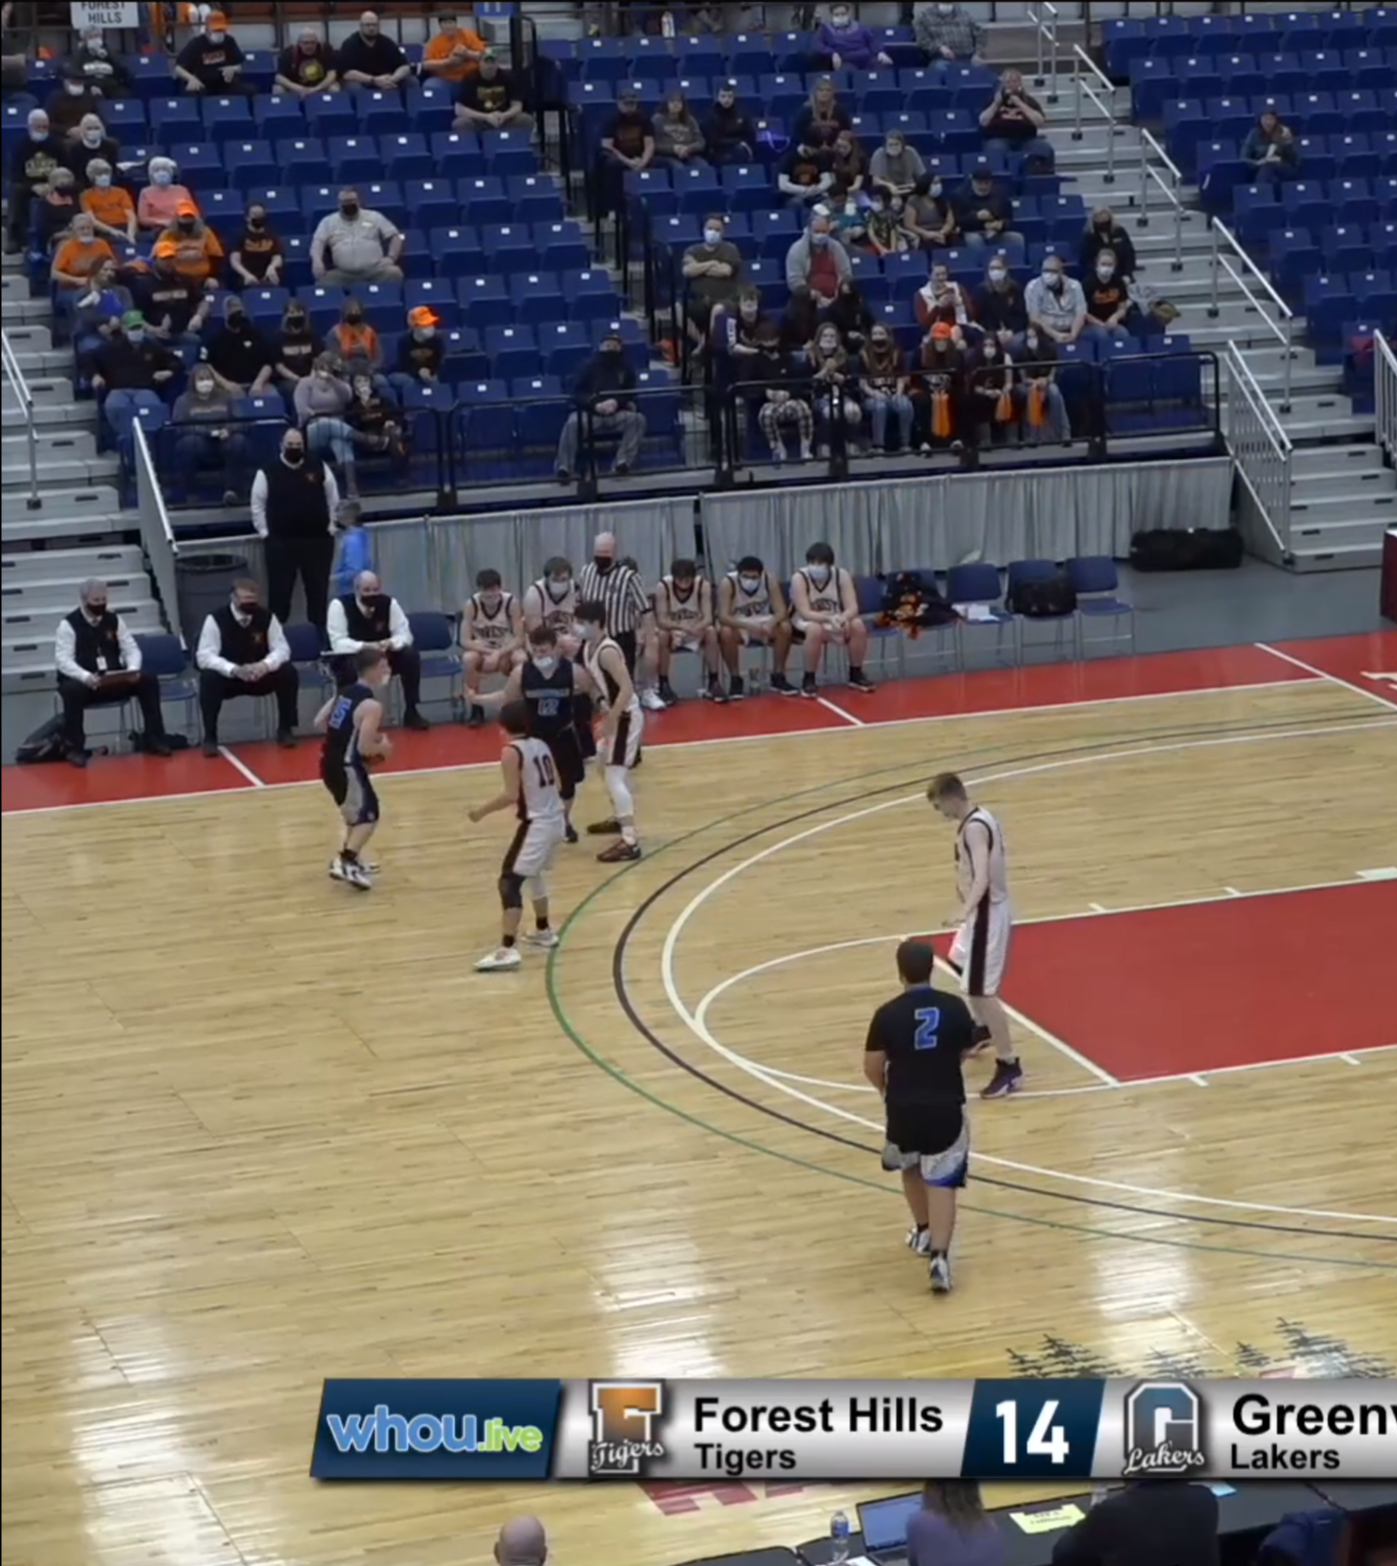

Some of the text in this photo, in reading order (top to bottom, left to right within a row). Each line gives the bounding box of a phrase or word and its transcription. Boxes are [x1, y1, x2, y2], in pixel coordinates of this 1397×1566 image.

[87, 12, 123, 24] HILLS
[532, 753, 556, 789] 10
[914, 1007, 940, 1050] 2
